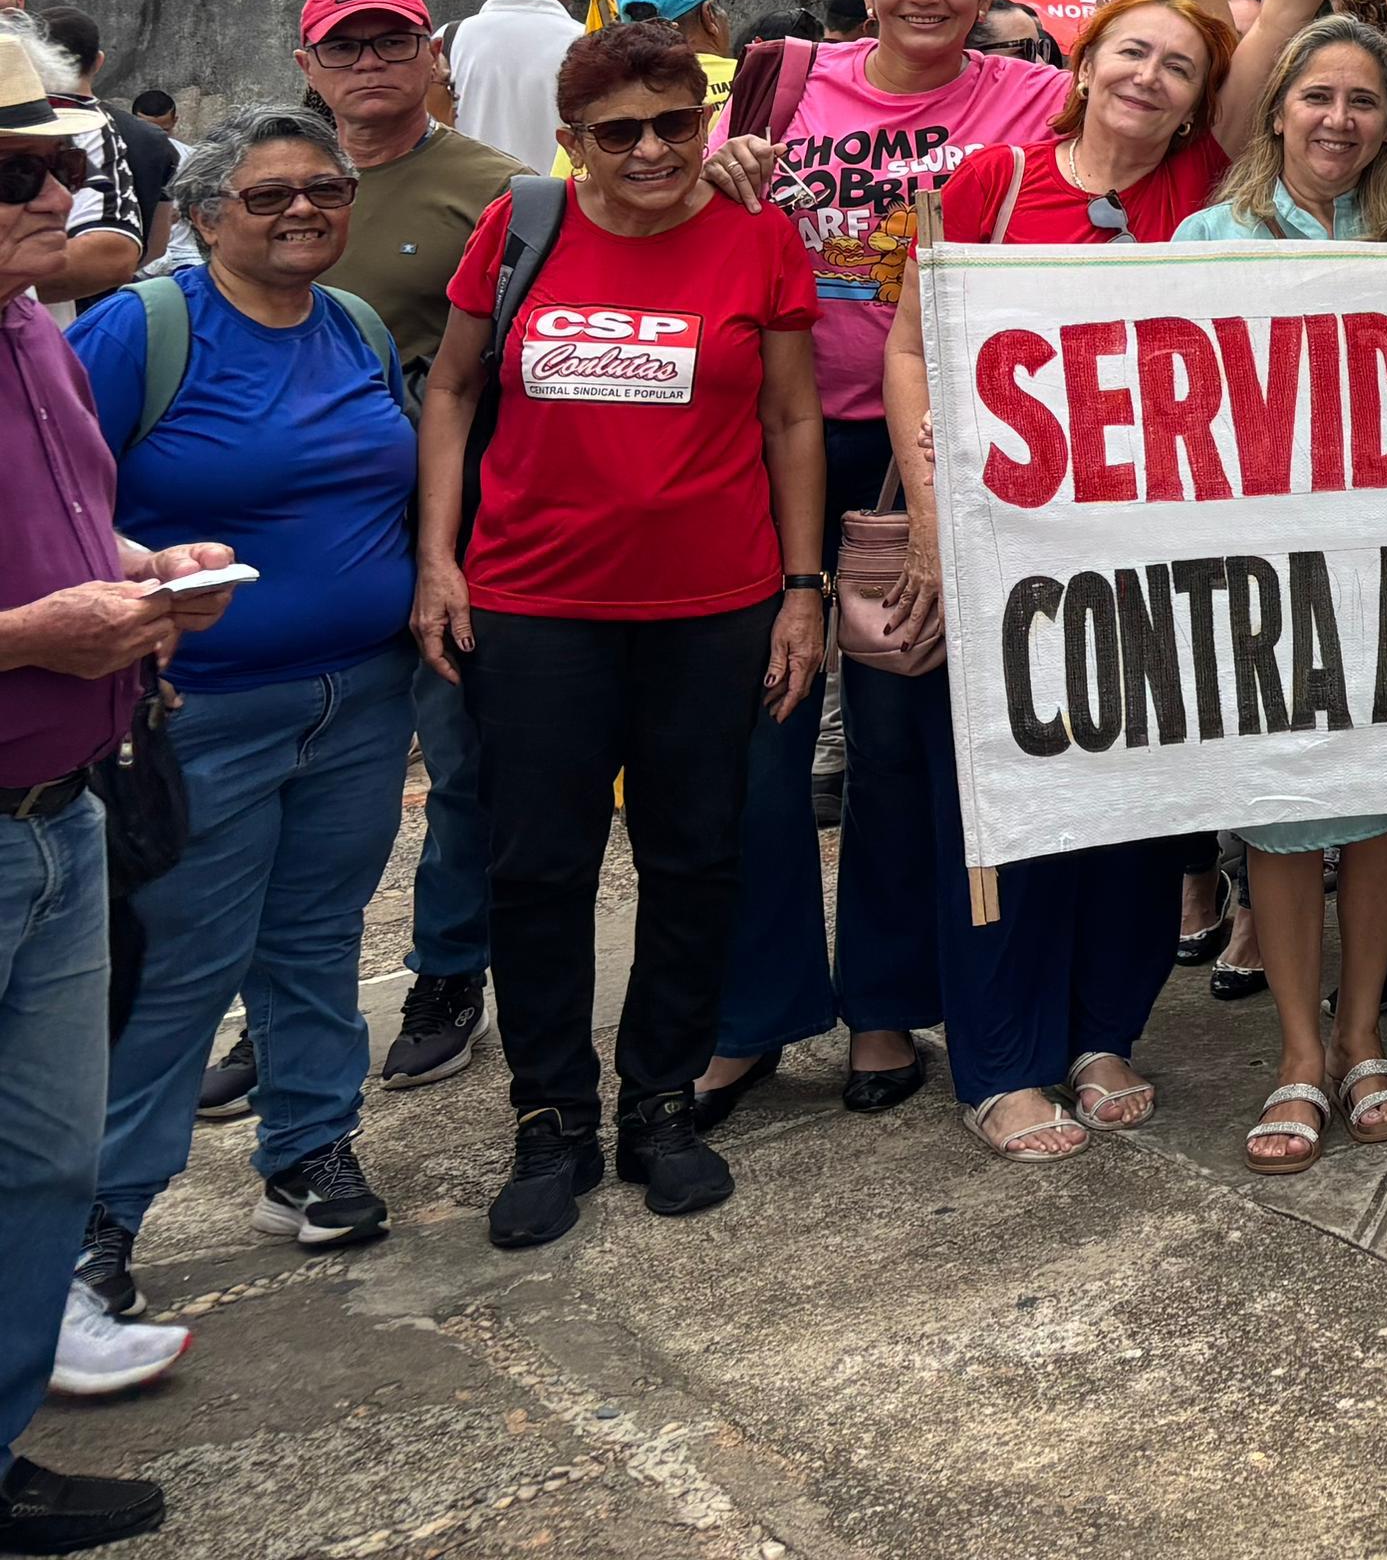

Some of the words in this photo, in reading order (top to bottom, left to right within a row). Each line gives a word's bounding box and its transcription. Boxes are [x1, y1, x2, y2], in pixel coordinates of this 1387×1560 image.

[778, 126, 949, 173] CHOMP
[536, 309, 689, 342] CSP
[532, 343, 678, 382] Conlutas
[529, 385, 570, 396] CENTRAL
[573, 386, 622, 398] SINDICAL
[624, 388, 631, 398] E
[634, 388, 684, 400] POPULAR
[1001, 550, 1353, 757] CONTRA
